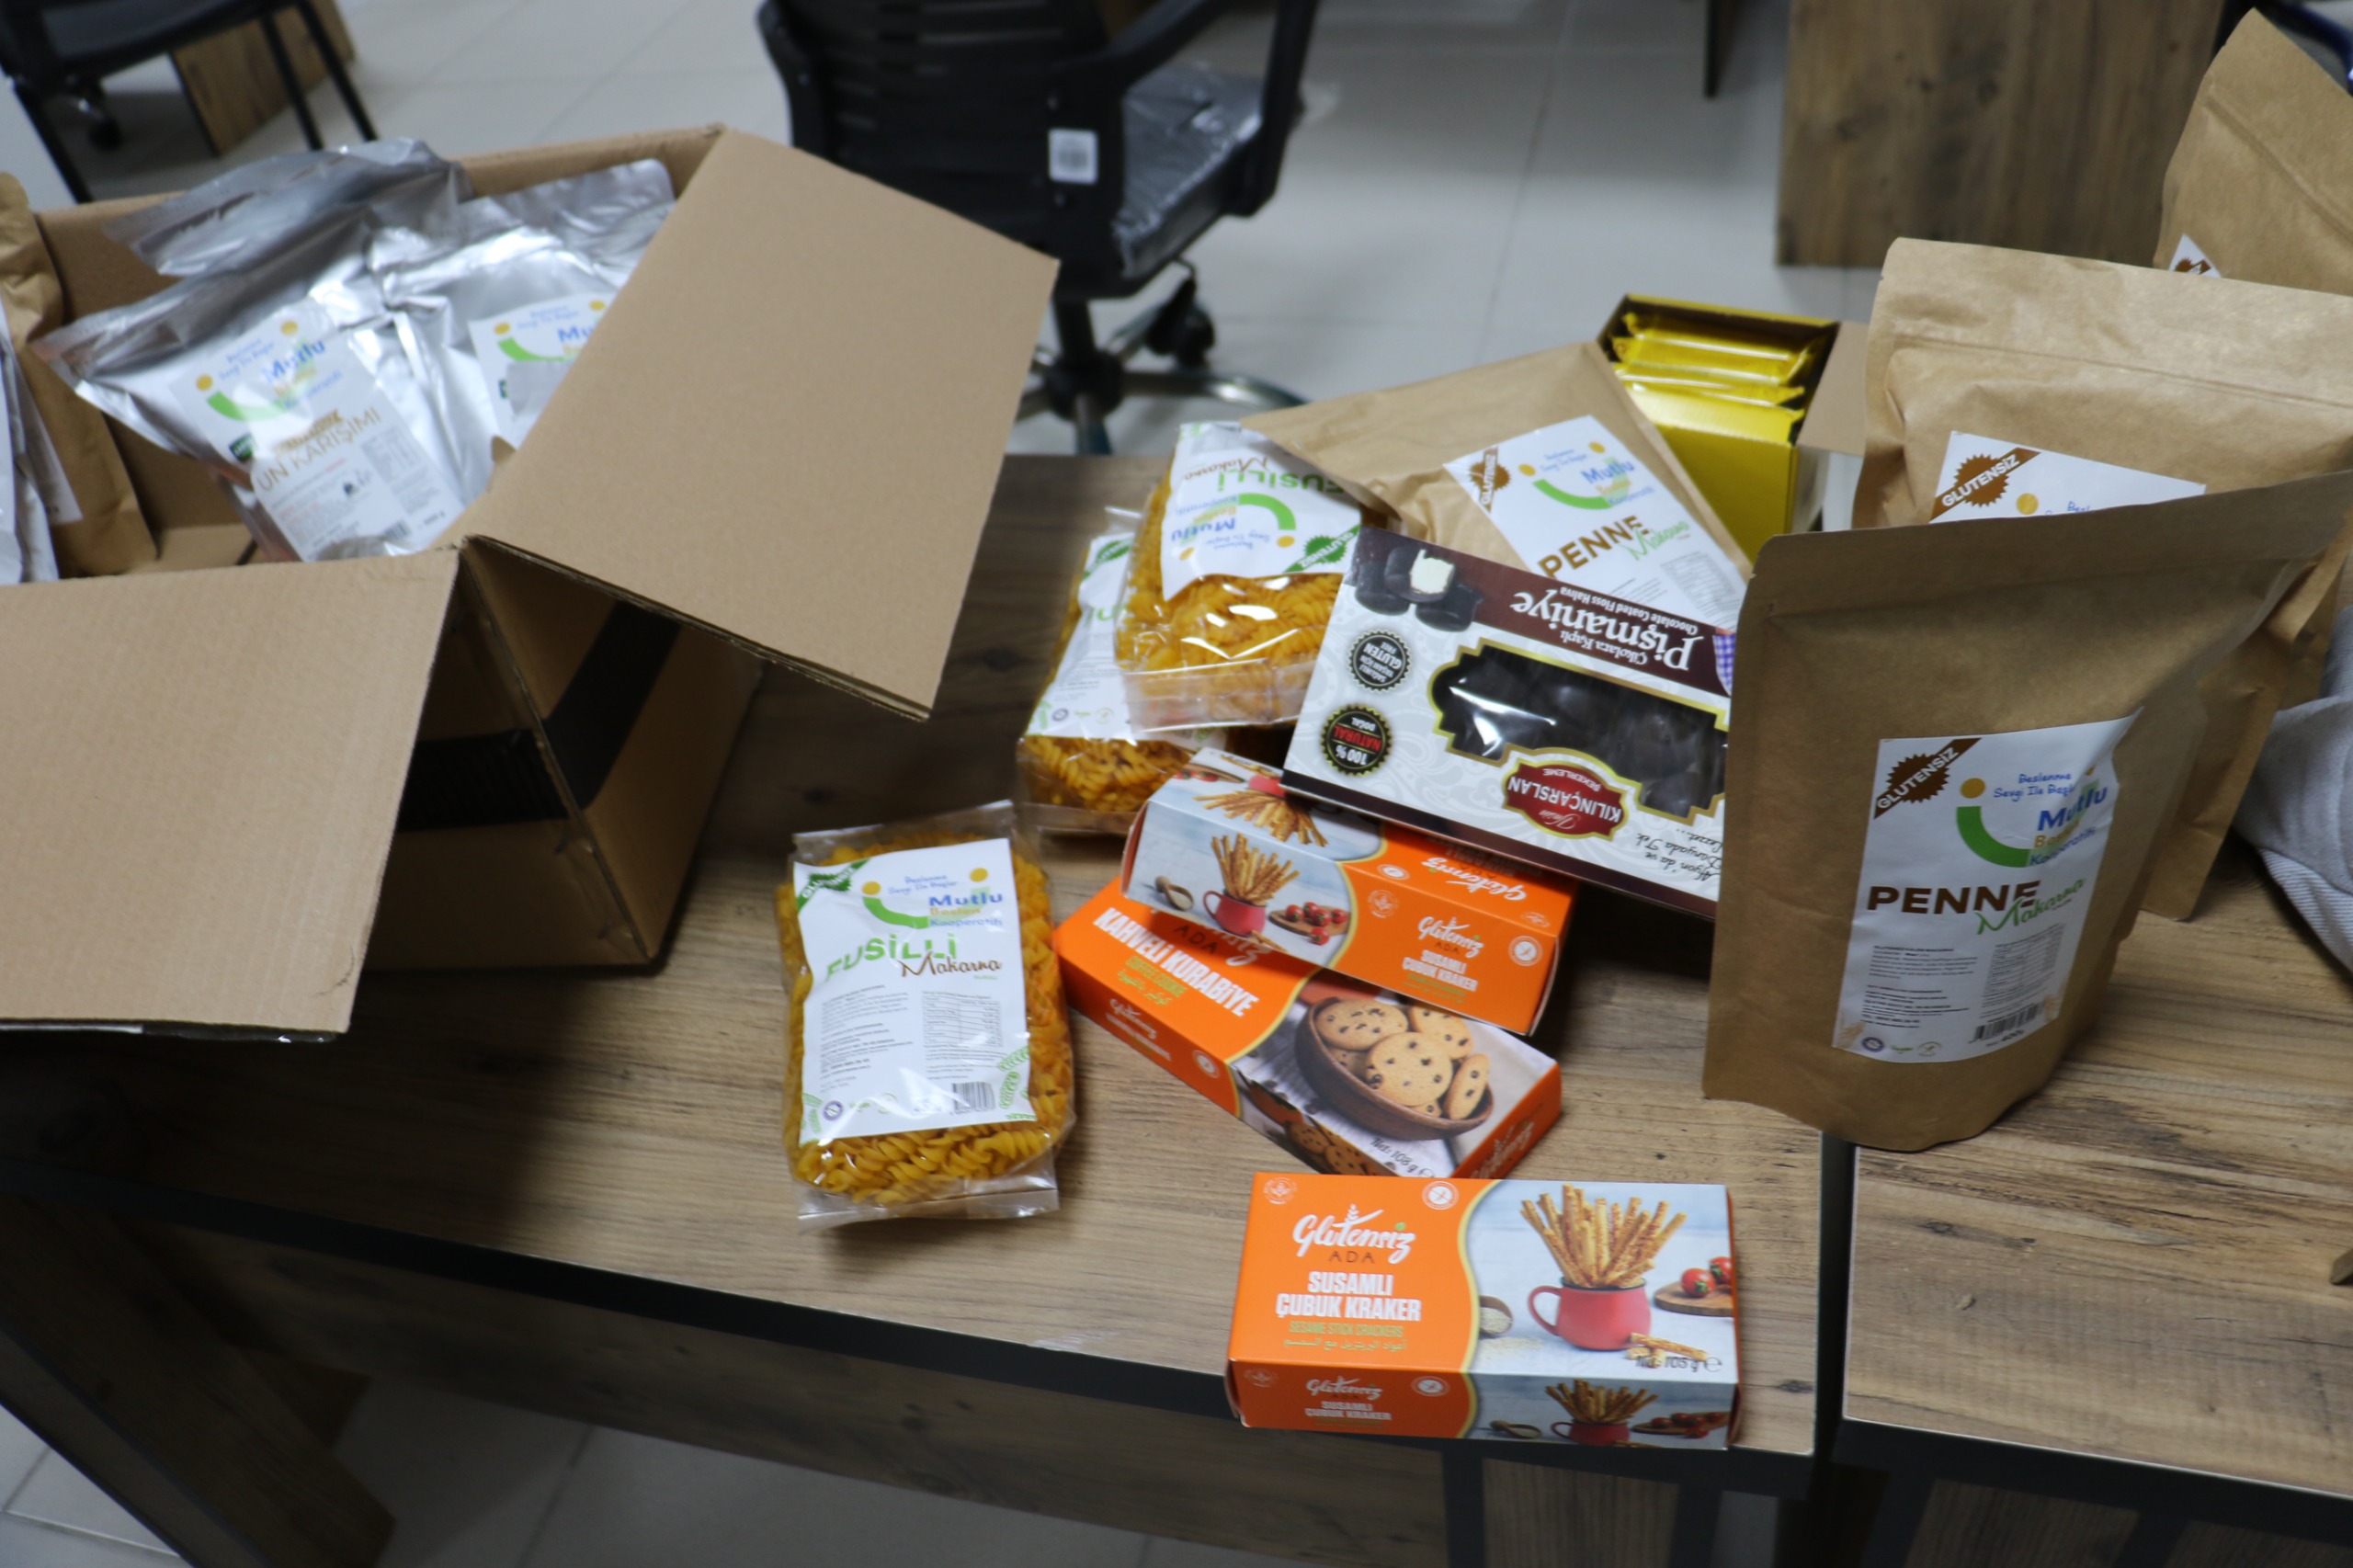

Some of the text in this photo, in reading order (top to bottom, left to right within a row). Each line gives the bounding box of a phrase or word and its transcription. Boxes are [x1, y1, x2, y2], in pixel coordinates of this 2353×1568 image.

[257, 462, 290, 492] UN
[1581, 460, 1635, 484] Mutlu
[1171, 518, 1236, 541] Mutlu
[1538, 515, 1650, 579] PENNE
[1591, 596, 1616, 613] Floss
[1617, 604, 1651, 621] Coated
[1510, 588, 1704, 671] Pişmaniye
[1651, 613, 1699, 635] Chocolate
[1364, 642, 1402, 670] GLUTEN
[1560, 630, 1648, 665] Çikolata Kaplı
[1334, 724, 1382, 752] NATURAL
[1347, 750, 1368, 766] 100
[1507, 777, 1622, 823] KILINÇARSLAN
[2037, 786, 2108, 832] Mutlu
[929, 892, 1003, 906] Mutlu
[1867, 880, 2041, 915] PENNE
[1974, 878, 2087, 936] Makarna
[1175, 923, 1219, 954] ADA
[897, 951, 1002, 977] Makarna
[1292, 1203, 1417, 1264] Glutensiz
[1328, 1251, 1375, 1264] ADA
[1308, 1271, 1393, 1296] SUSAMLI
[1276, 1293, 1422, 1322] ÇUBUK KRAKER
